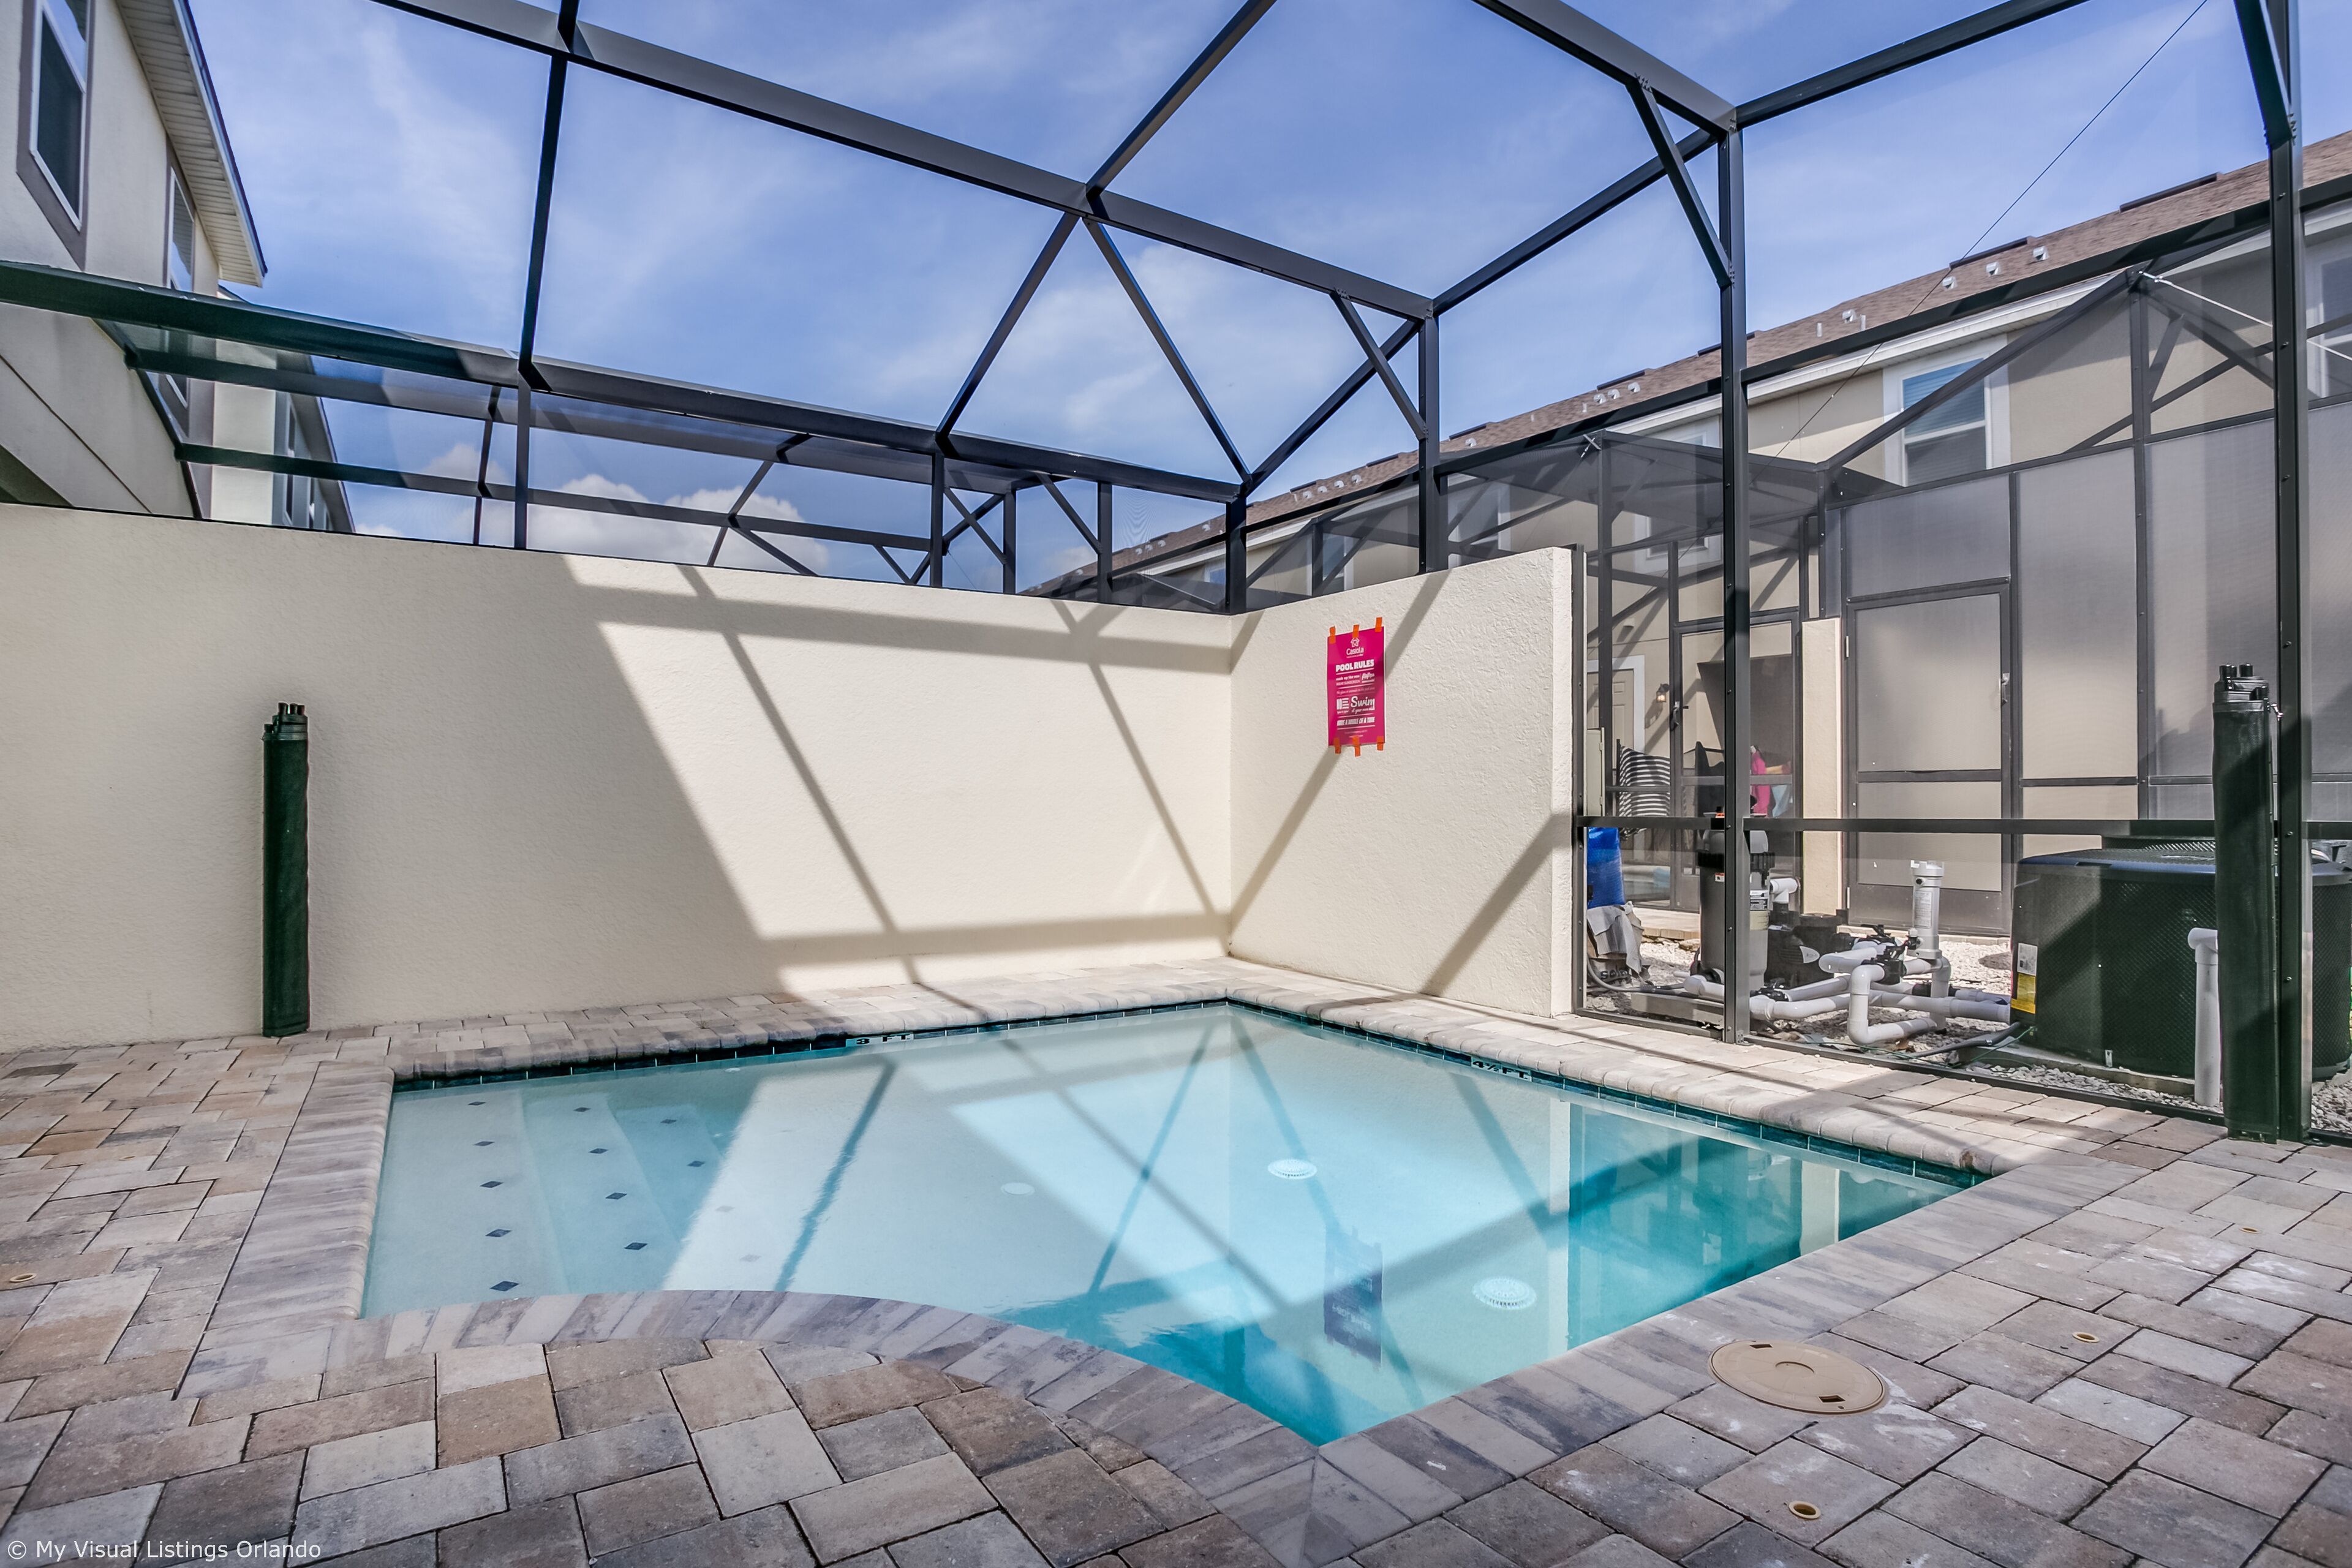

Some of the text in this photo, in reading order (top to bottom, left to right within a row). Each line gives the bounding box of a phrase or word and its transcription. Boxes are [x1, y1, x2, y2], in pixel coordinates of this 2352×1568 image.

[1336, 659, 1374, 672] POOL RULES
[1351, 696, 1375, 707] Swim
